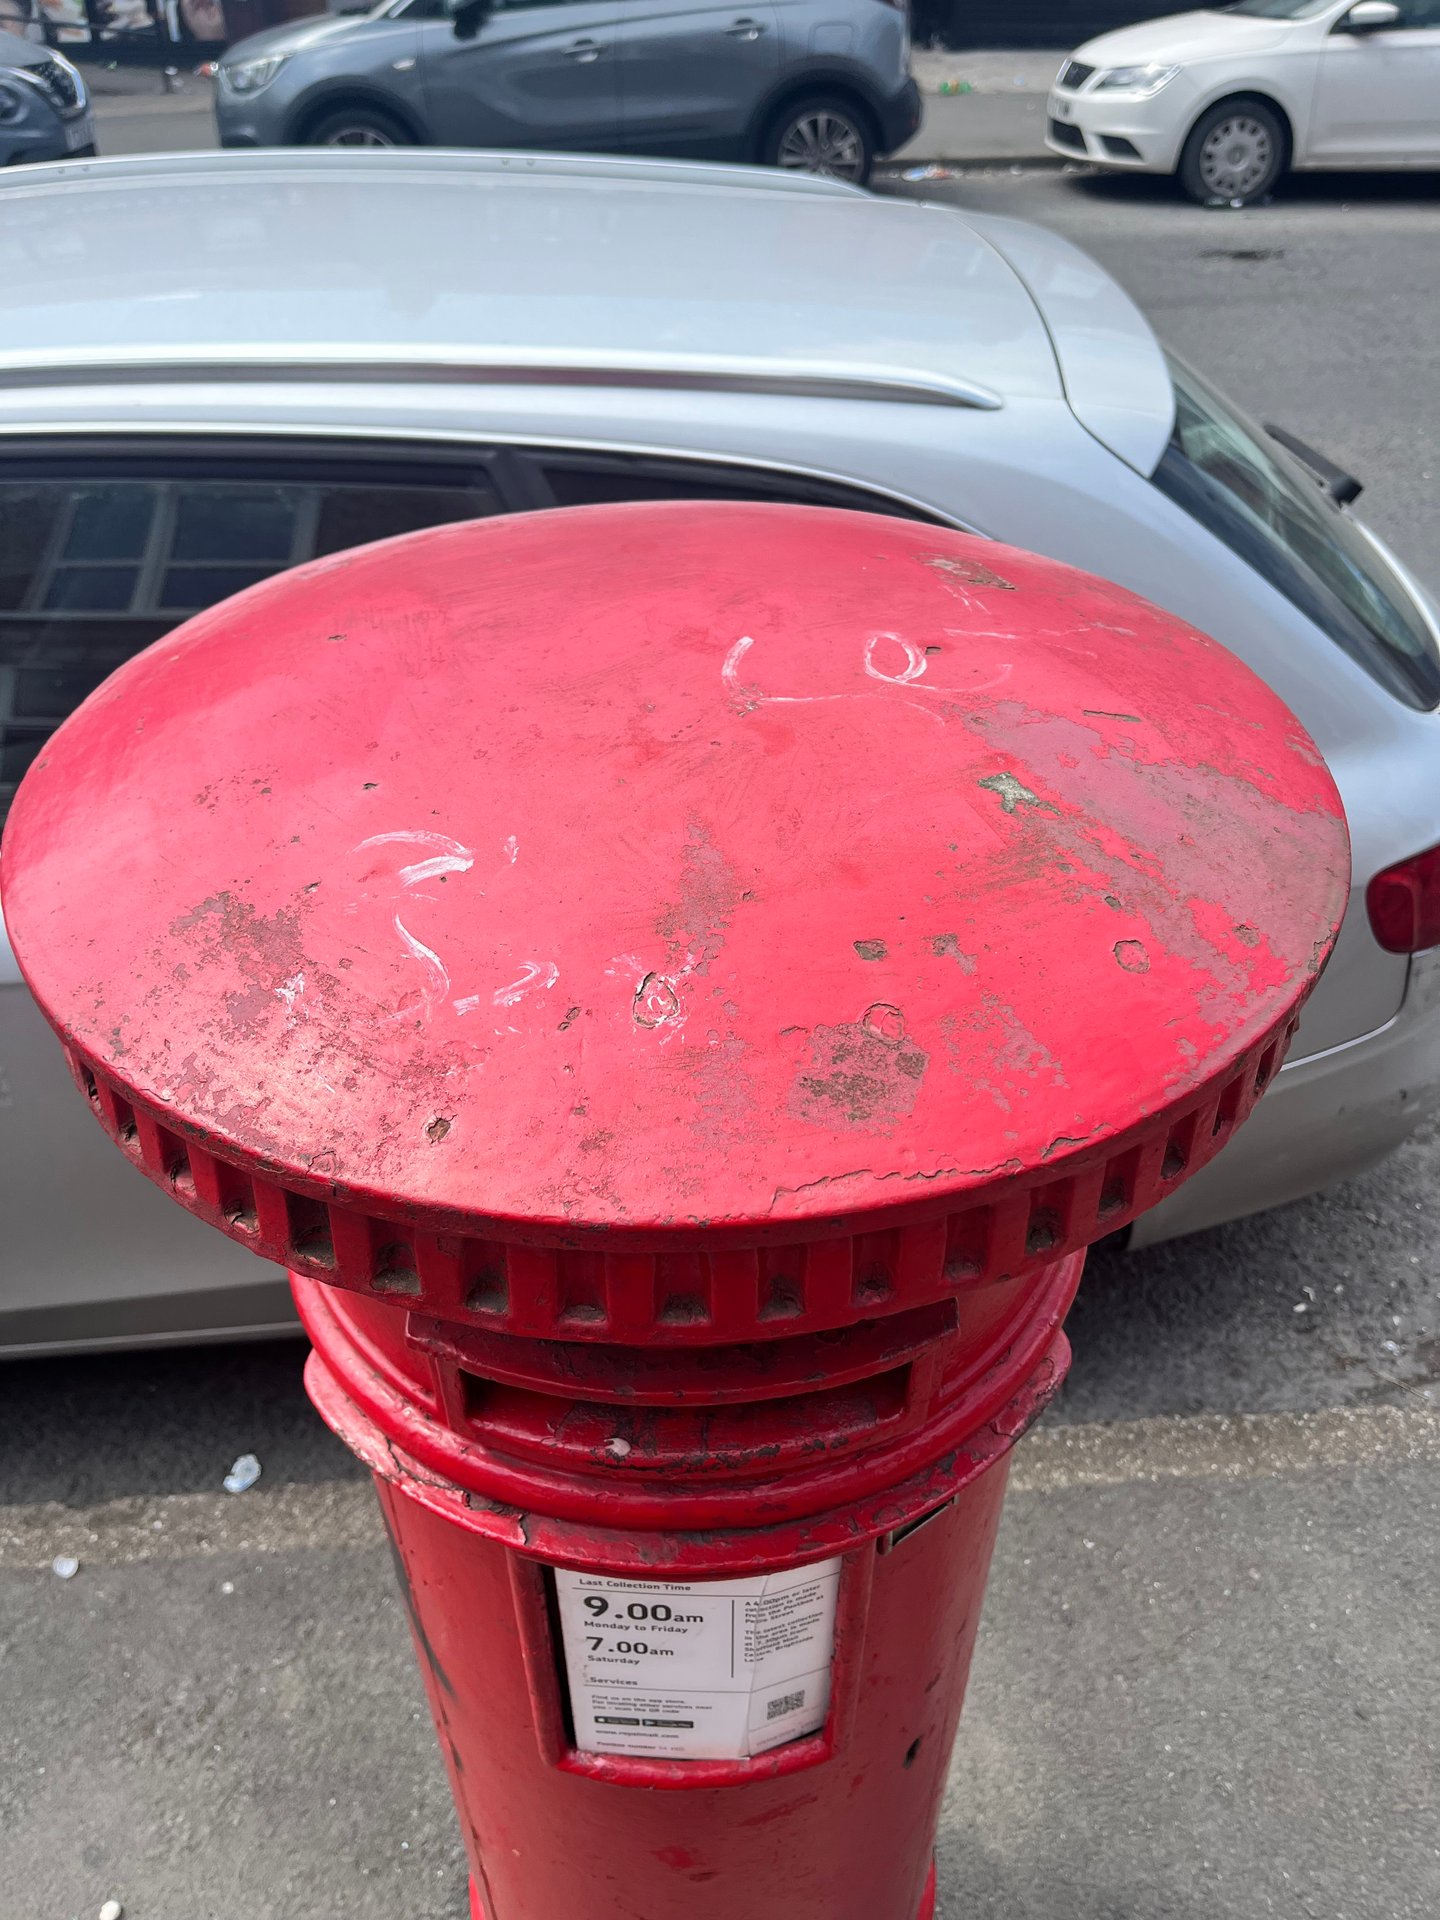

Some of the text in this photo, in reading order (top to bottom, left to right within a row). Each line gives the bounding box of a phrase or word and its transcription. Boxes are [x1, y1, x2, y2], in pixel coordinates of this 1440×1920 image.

[579, 1578, 602, 1586] Last
[606, 1580, 660, 1590] Collection
[583, 1596, 704, 1622] 9.00am
[584, 1621, 630, 1631] Monday
[651, 1625, 688, 1634] Friday
[586, 1636, 674, 1656] 7.00am
[588, 1655, 640, 1665] Saturday
[590, 1676, 638, 1686] Services
